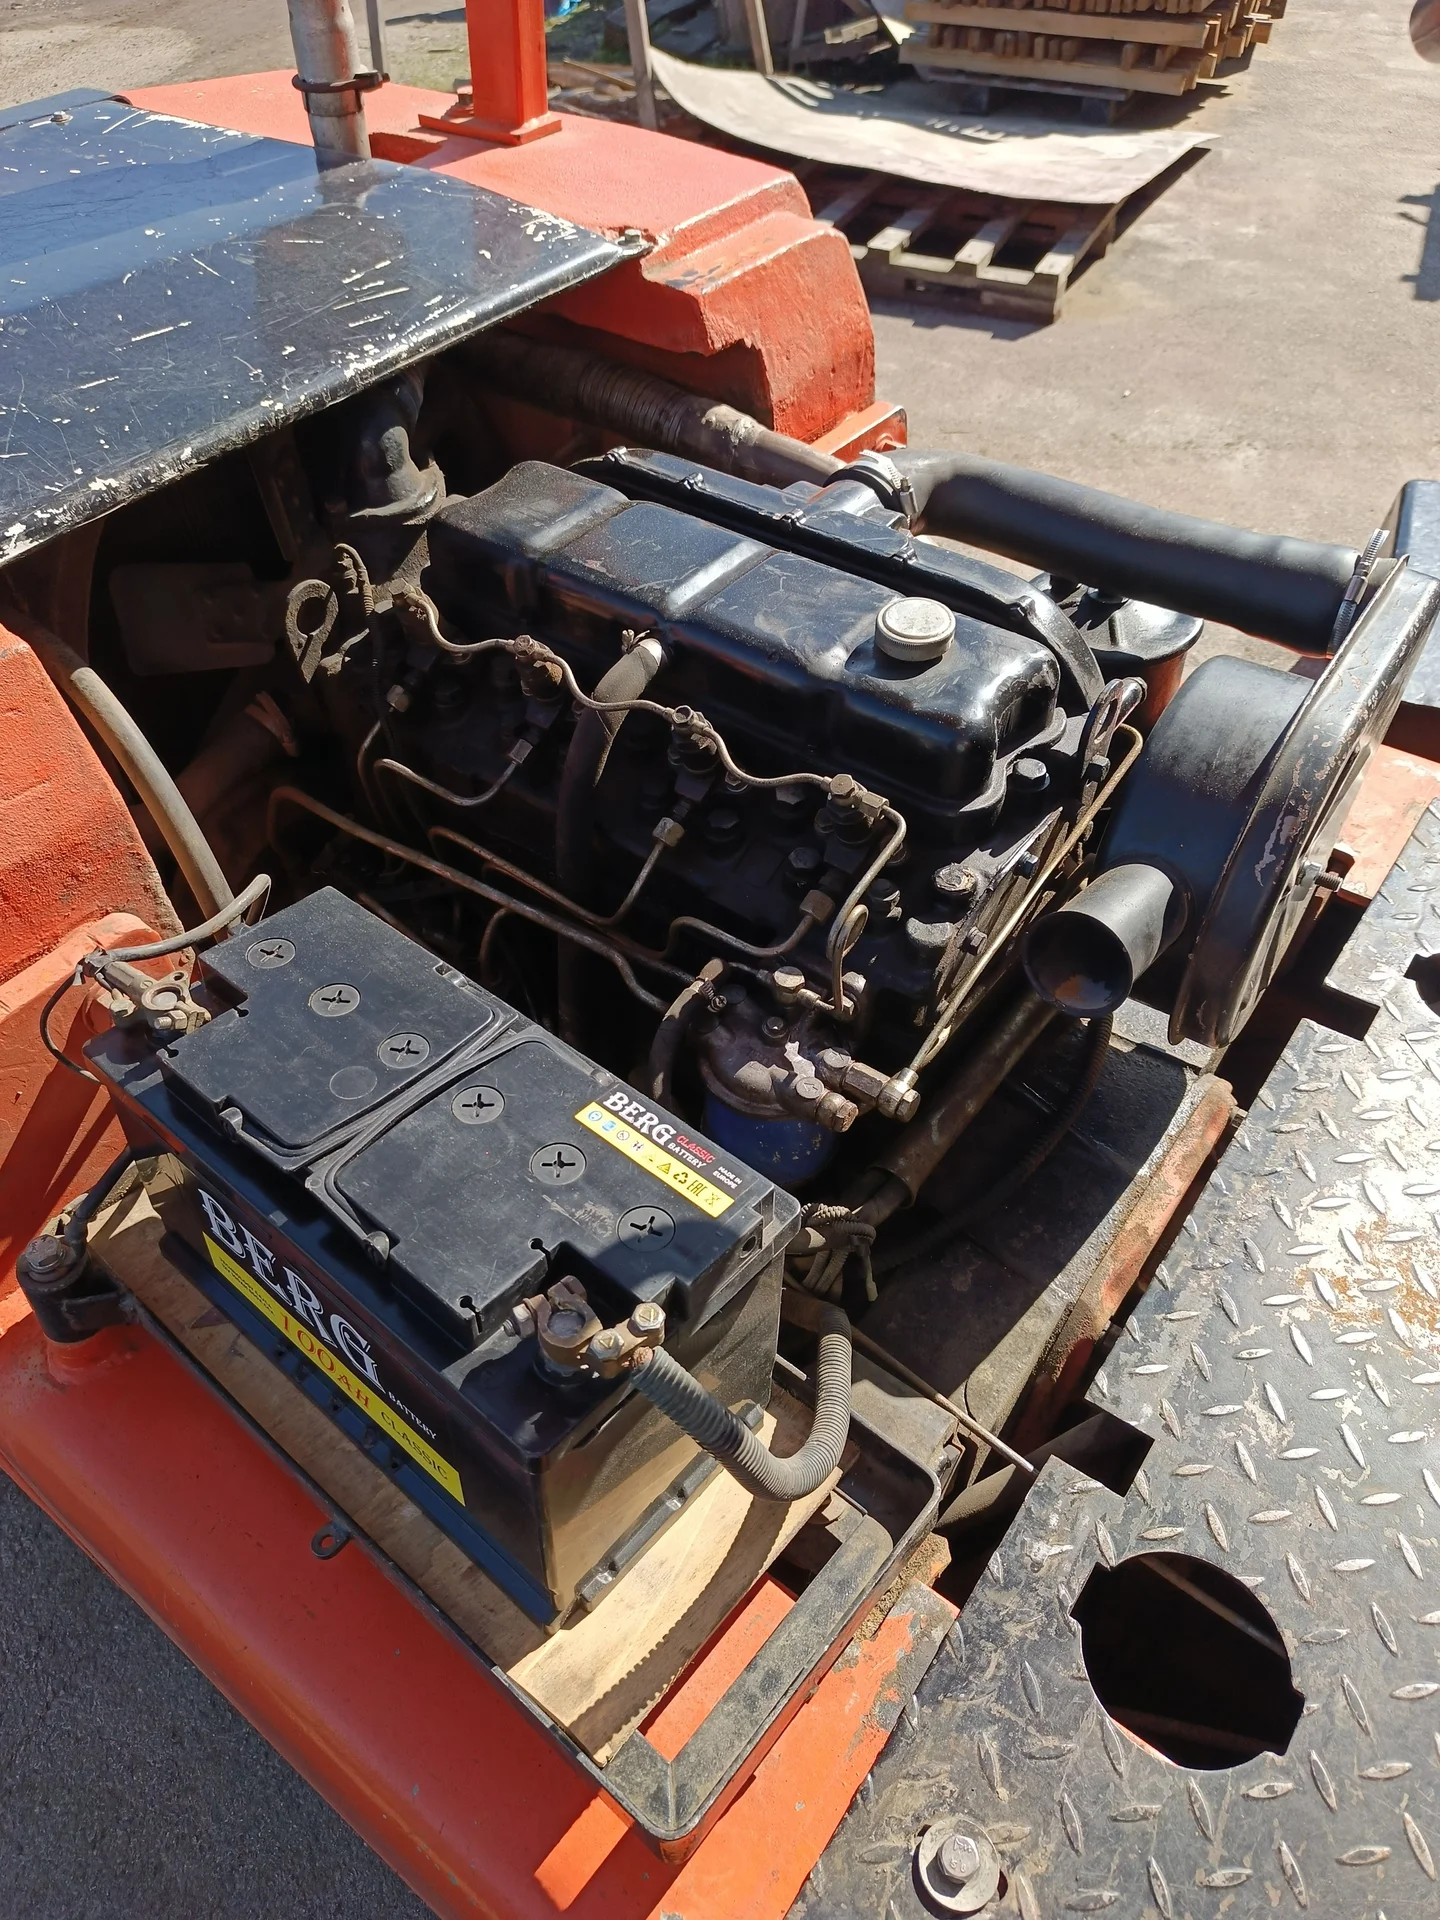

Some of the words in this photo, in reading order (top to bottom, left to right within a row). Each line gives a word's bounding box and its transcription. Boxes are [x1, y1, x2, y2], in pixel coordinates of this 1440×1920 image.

[603, 1092, 676, 1146] BERG
[667, 1142, 707, 1168] BATTERY
[676, 1135, 715, 1163] CLASSIC
[712, 1170, 738, 1189] EUROPE
[718, 1166, 735, 1180] MADE
[733, 1175, 743, 1185] IN
[197, 1188, 387, 1394] BERG
[388, 1391, 437, 1440] BATTERY
[380, 1411, 449, 1480] CLASSIC
